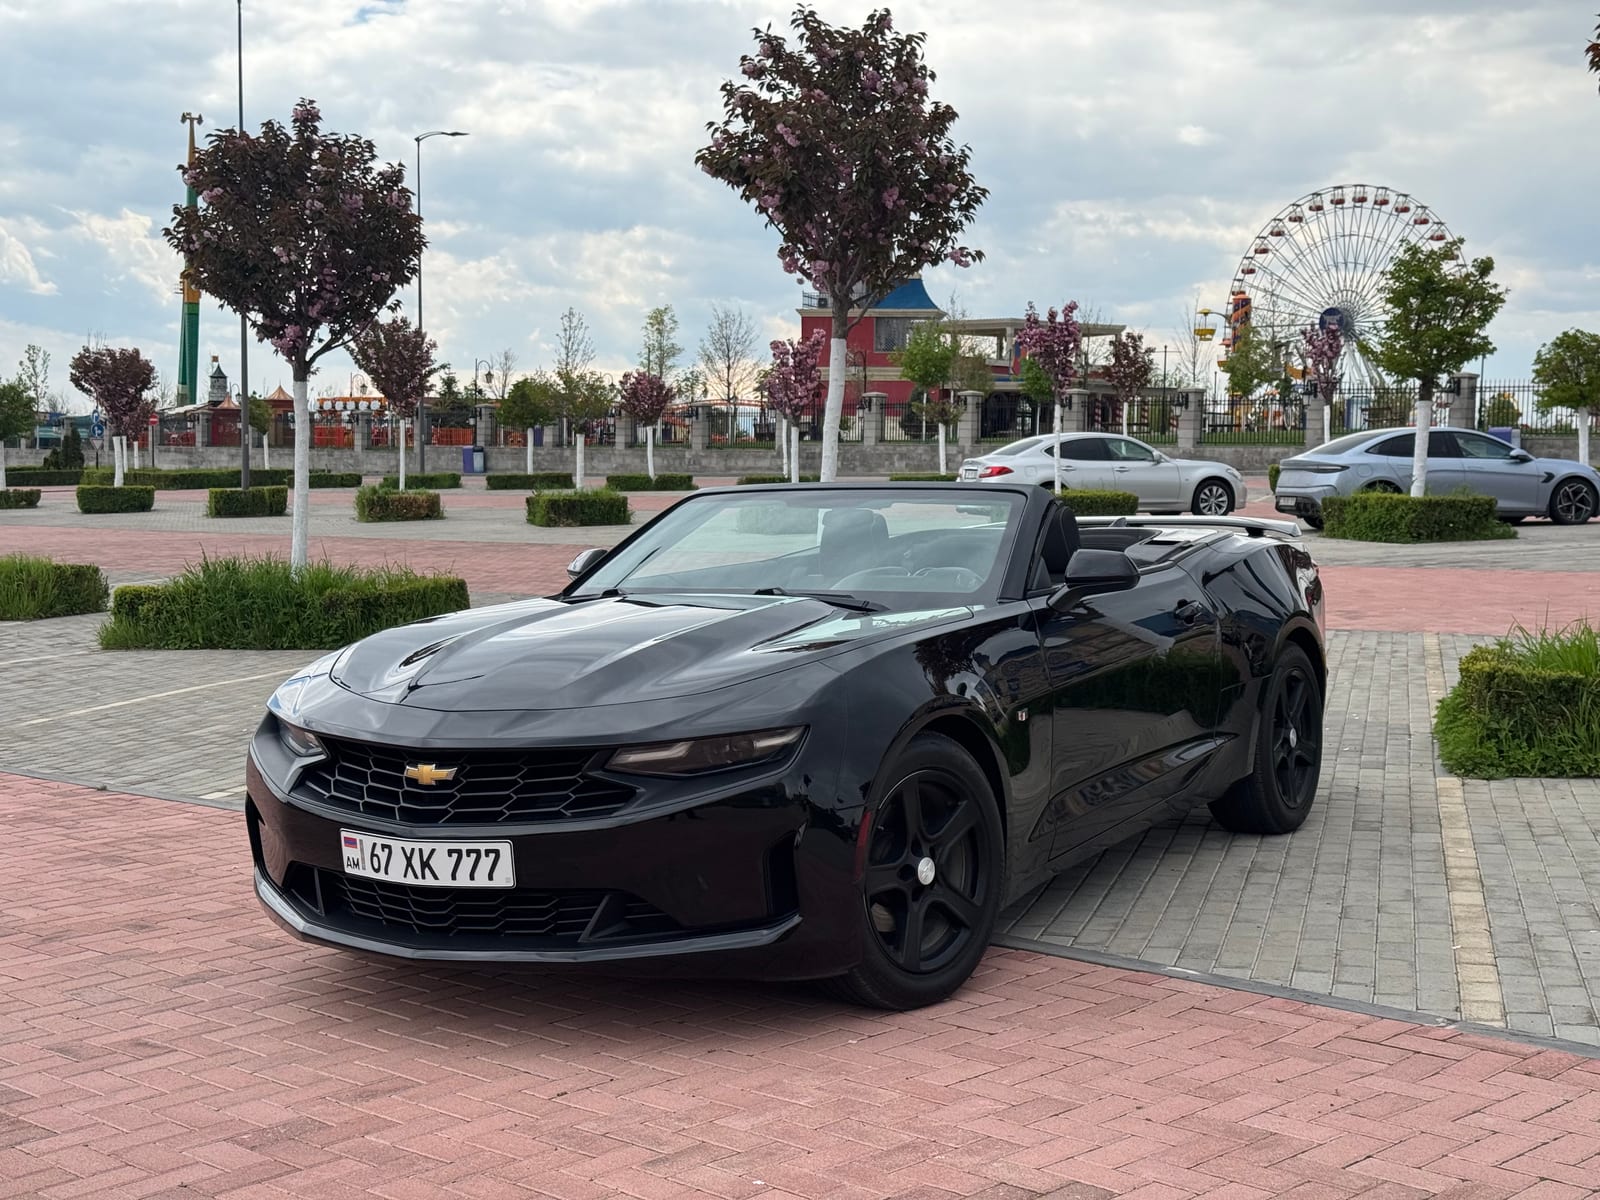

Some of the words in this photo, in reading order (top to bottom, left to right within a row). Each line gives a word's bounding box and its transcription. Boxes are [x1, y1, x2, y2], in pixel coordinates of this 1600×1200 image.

[346, 856, 360, 871] AM
[370, 842, 393, 876] 67
[401, 846, 439, 881] XK
[447, 849, 501, 882] 777
